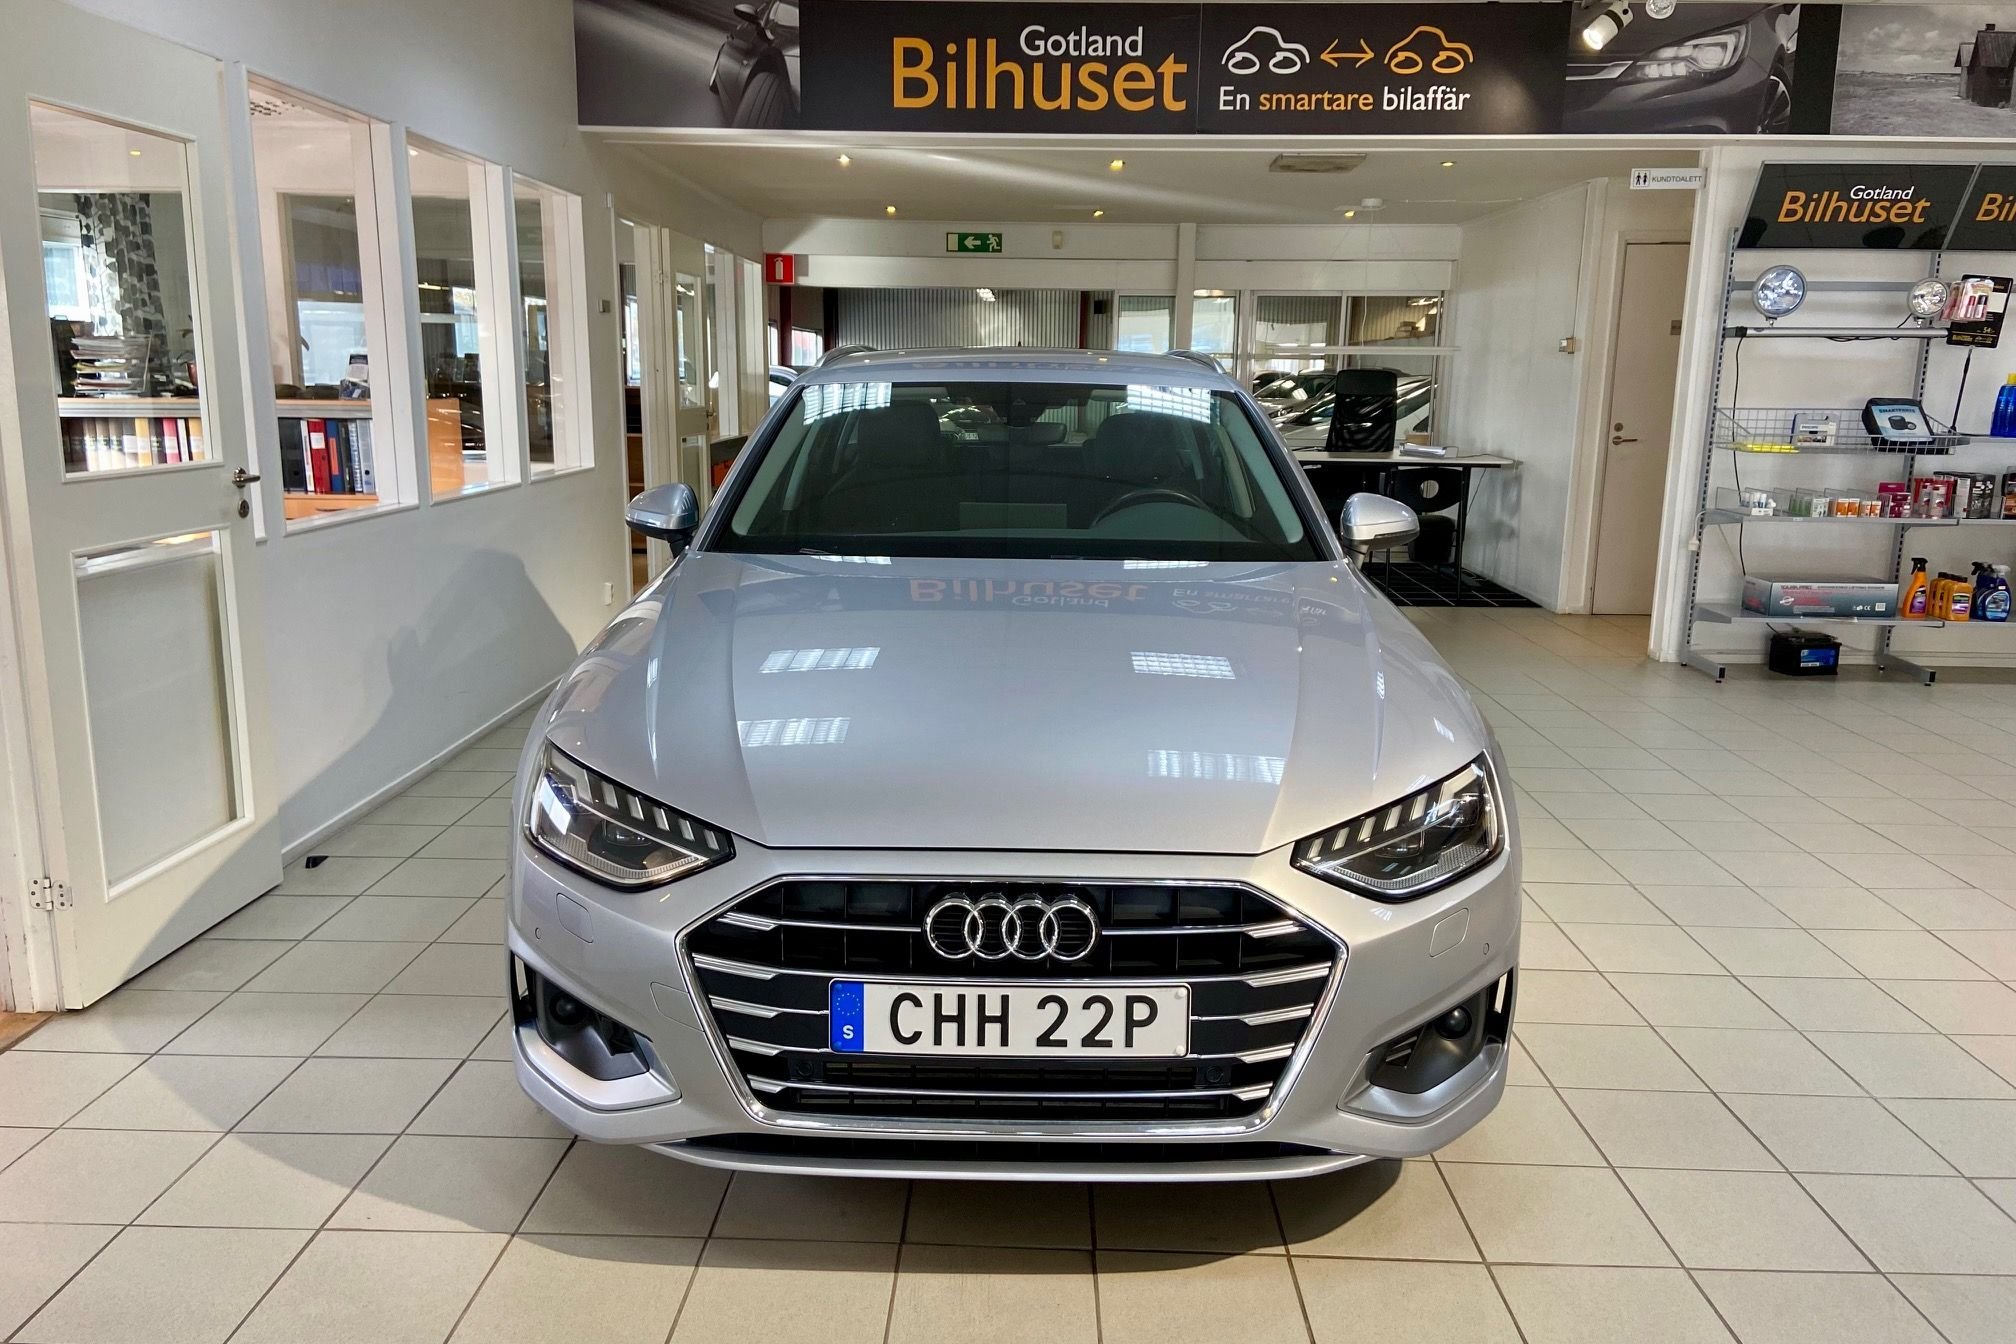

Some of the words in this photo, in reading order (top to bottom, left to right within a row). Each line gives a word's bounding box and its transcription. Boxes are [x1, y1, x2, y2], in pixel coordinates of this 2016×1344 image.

[1019, 25, 1143, 57] Gotland
[893, 37, 1188, 112] Bilhuset
[1219, 86, 1250, 110] En
[1259, 90, 1374, 111] smartare
[1382, 85, 1471, 111] bilaffär
[1651, 175, 1703, 183] KUNDTOALETT
[1850, 185, 1915, 200] Gotland
[1777, 191, 1931, 223] Bilhuset
[842, 1024, 854, 1040] S
[889, 992, 1010, 1047] CHH
[1036, 994, 1158, 1048] 22P
